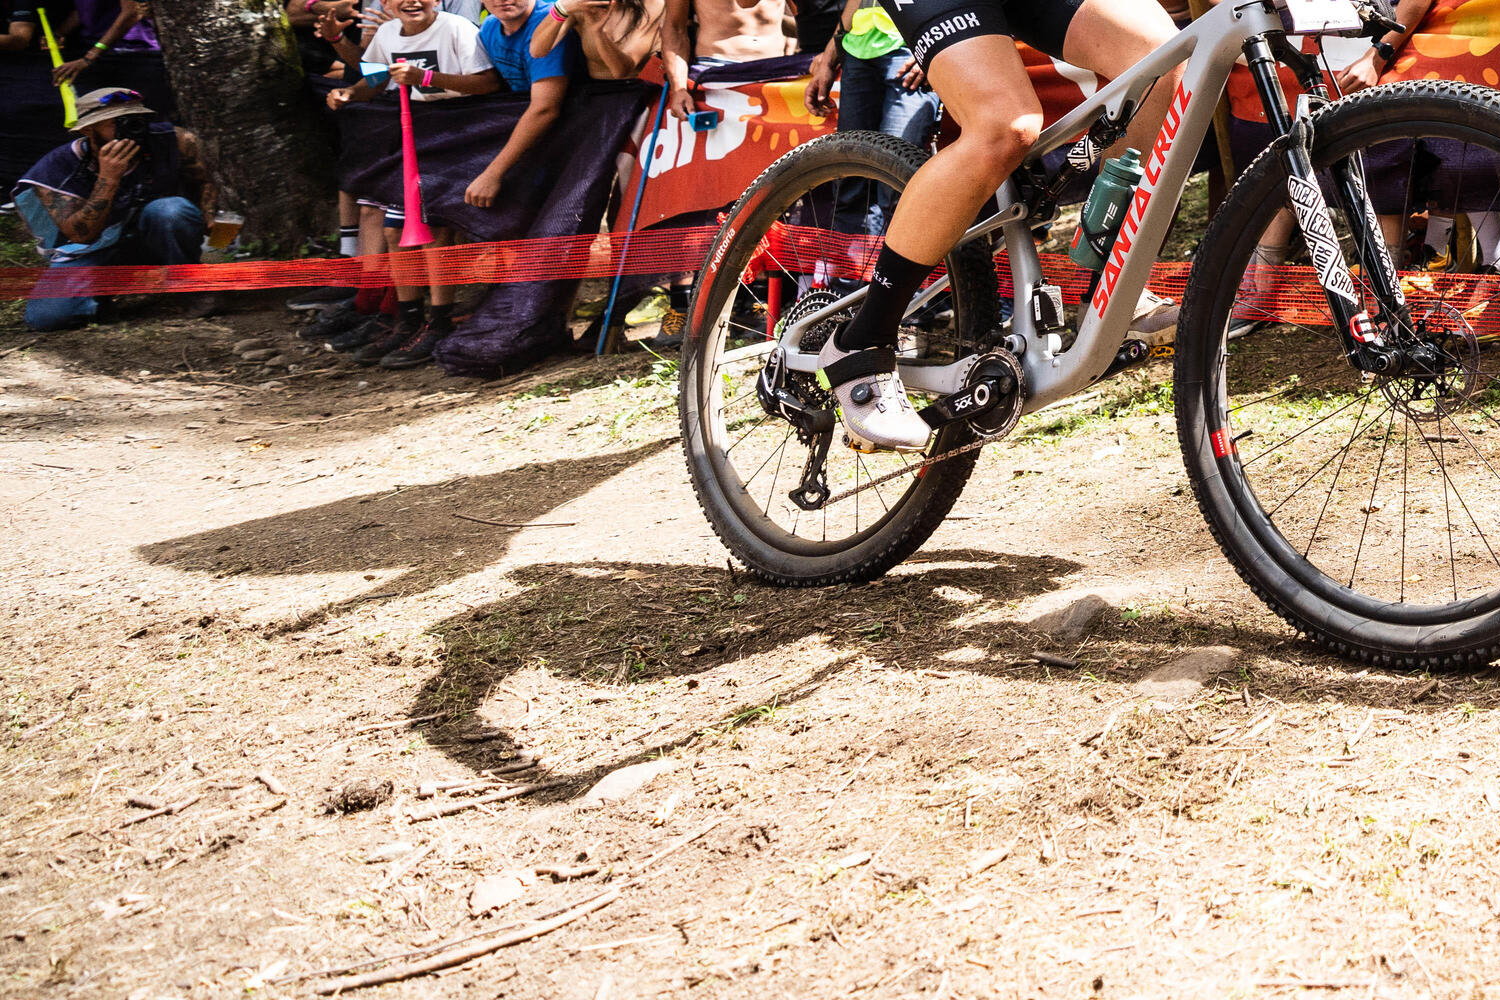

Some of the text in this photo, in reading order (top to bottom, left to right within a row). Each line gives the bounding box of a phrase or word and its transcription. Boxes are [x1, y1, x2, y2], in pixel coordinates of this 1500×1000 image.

[914, 12, 980, 65] ROCKSHOX
[1092, 80, 1192, 320] SANTA CRUZ
[1289, 180, 1318, 208] ROCK
[714, 228, 735, 264] vittoria
